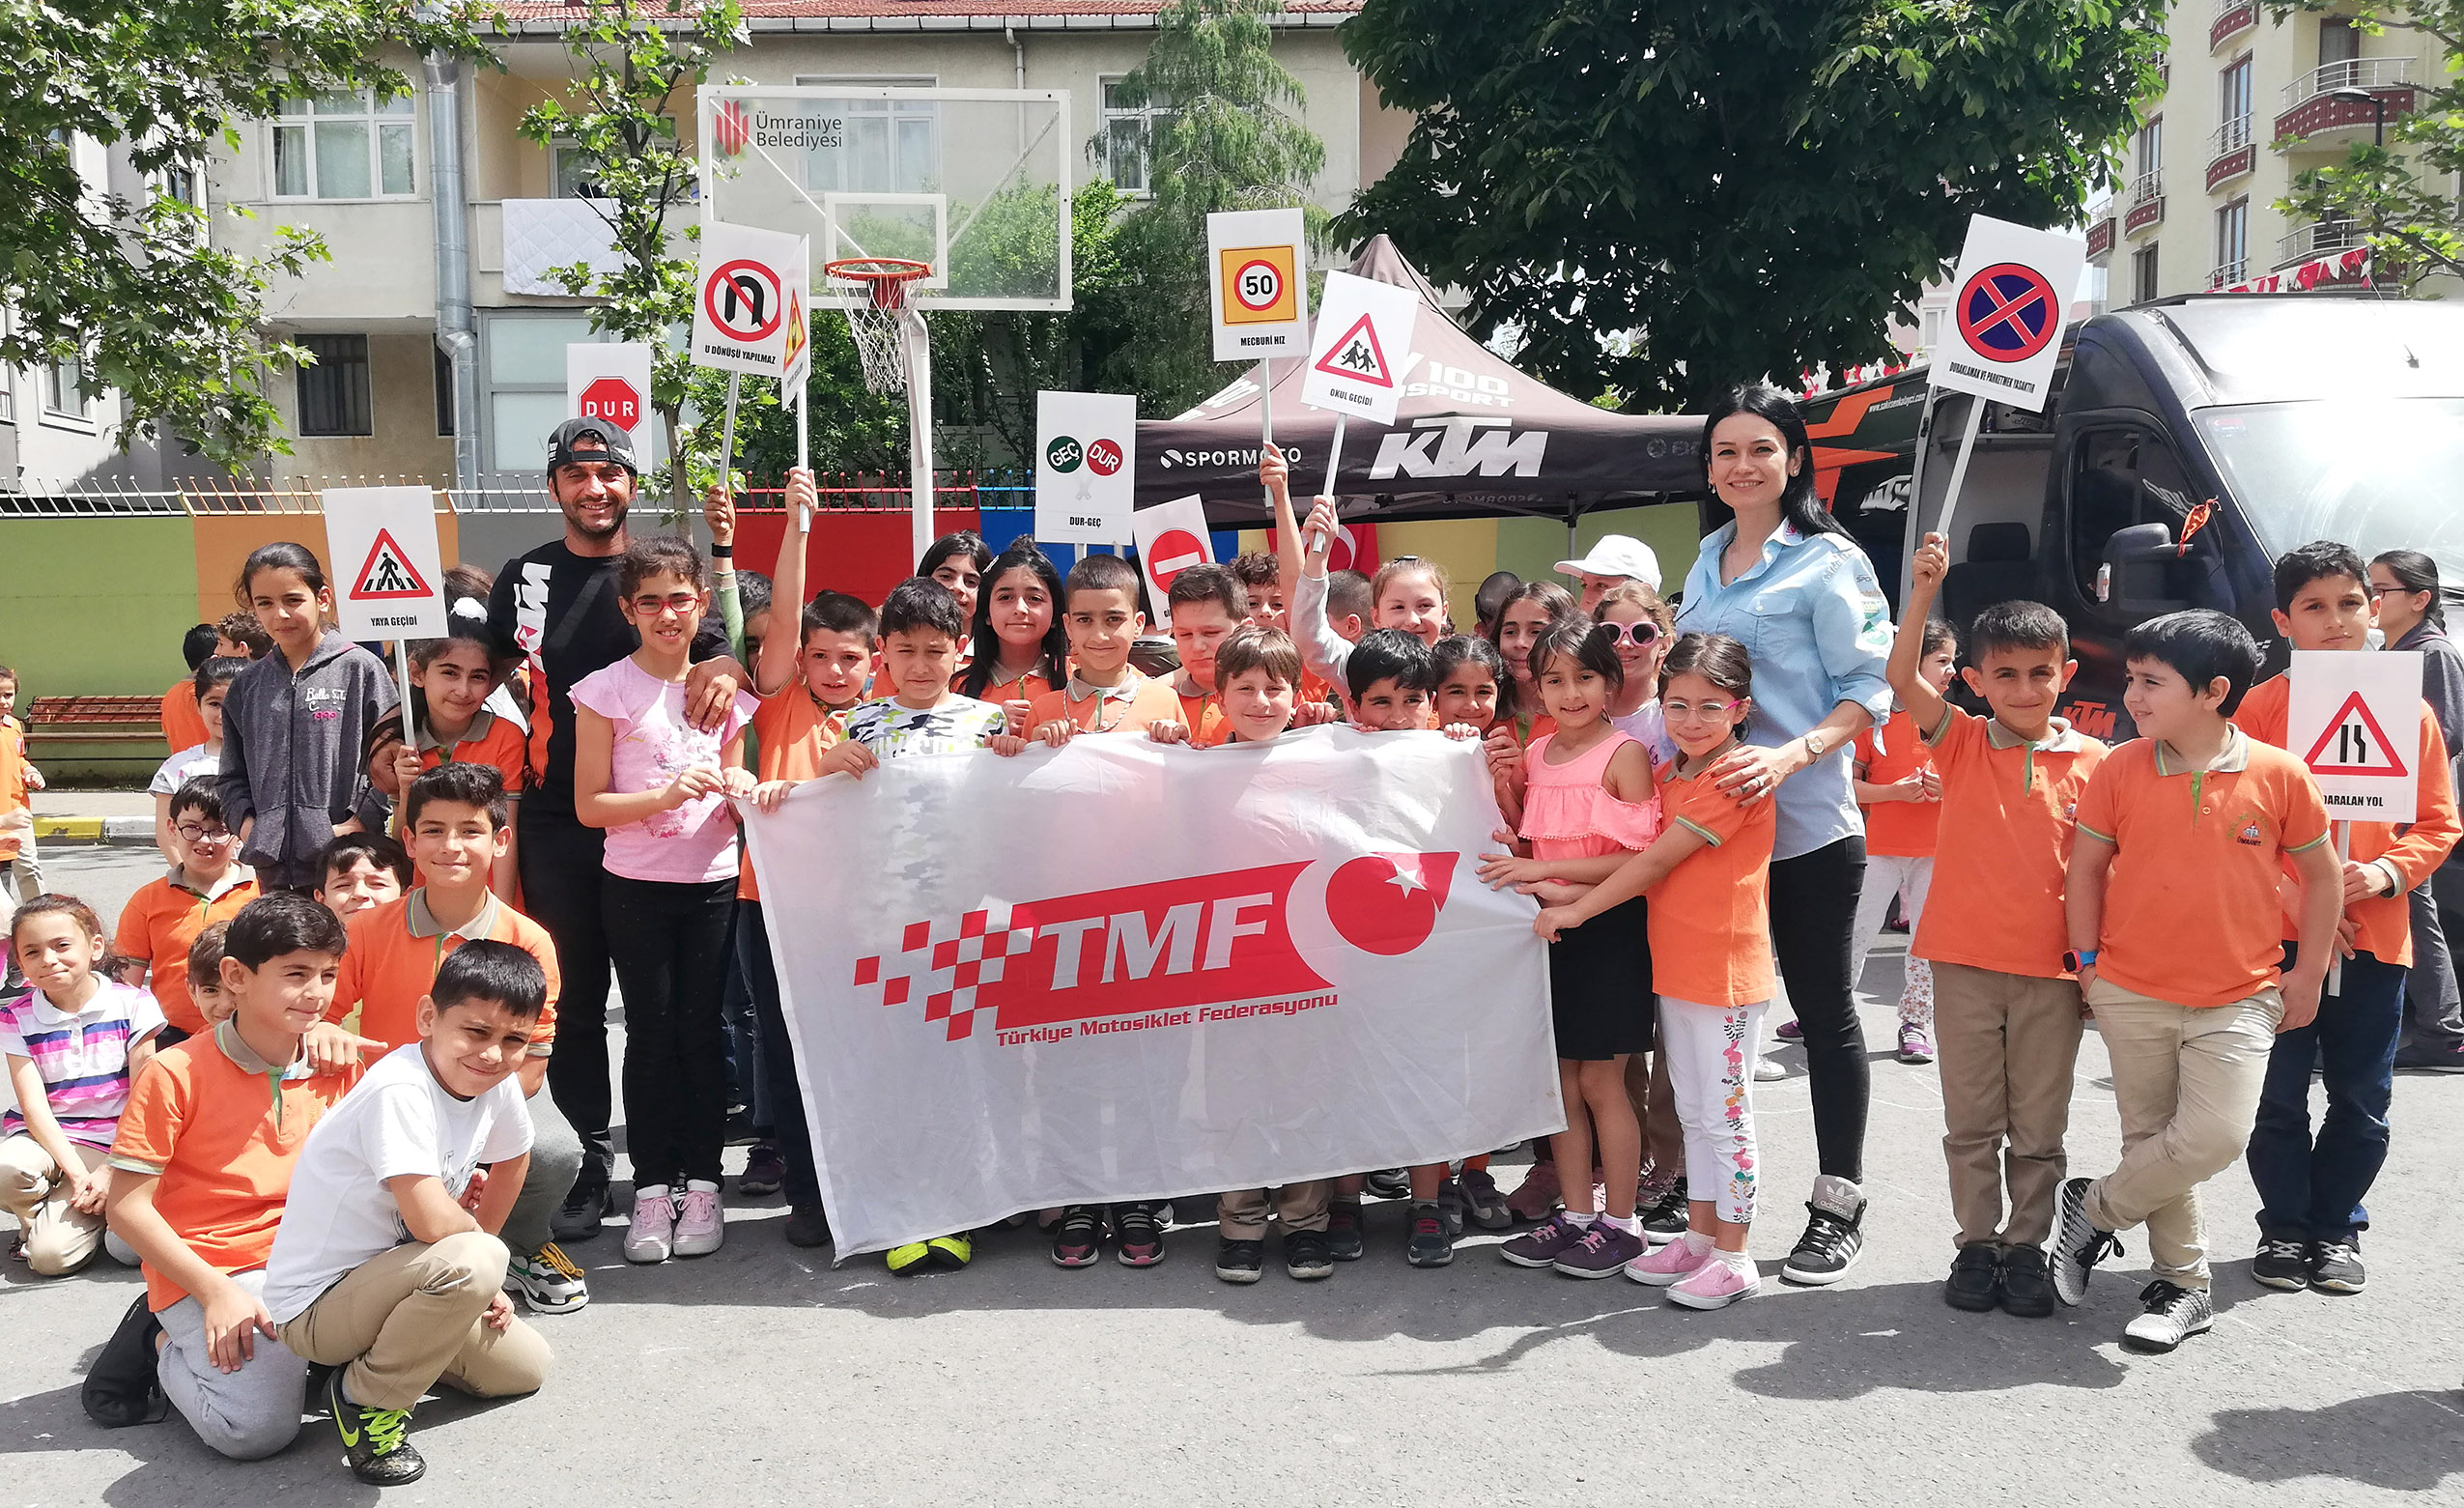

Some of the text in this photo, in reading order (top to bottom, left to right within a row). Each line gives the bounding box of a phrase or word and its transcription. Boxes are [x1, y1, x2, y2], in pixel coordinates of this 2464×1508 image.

[756, 110, 842, 134] Ümraniye
[756, 131, 842, 152] Belediyesi
[1245, 274, 1273, 296] 50
[1240, 334, 1286, 346] MECBURİ HIZ
[704, 344, 777, 365] U DÖNÜŞÜ YAPILMAZ
[1429, 360, 1509, 396] 100
[1949, 361, 1981, 380] DURAKLAMAK
[1980, 369, 1988, 382] VE
[1986, 372, 2014, 387] PARKETMEK
[1329, 387, 1373, 407] OKUL GEÇİDİ
[584, 400, 635, 417] DUR
[1050, 441, 1080, 468] GEÇ
[1089, 443, 1119, 472] DUR
[1369, 415, 1549, 480] KTM
[1069, 516, 1102, 529] DUR-GEÇ
[370, 615, 418, 627] YAYA GEÇİDİ
[2062, 700, 2116, 738] KTM
[2365, 796, 2384, 807] YOL
[1037, 892, 1273, 991] TMF
[996, 993, 1339, 1047] Türkiye Motosiklet Federasyonu
[1820, 1200, 1848, 1216] adidas
